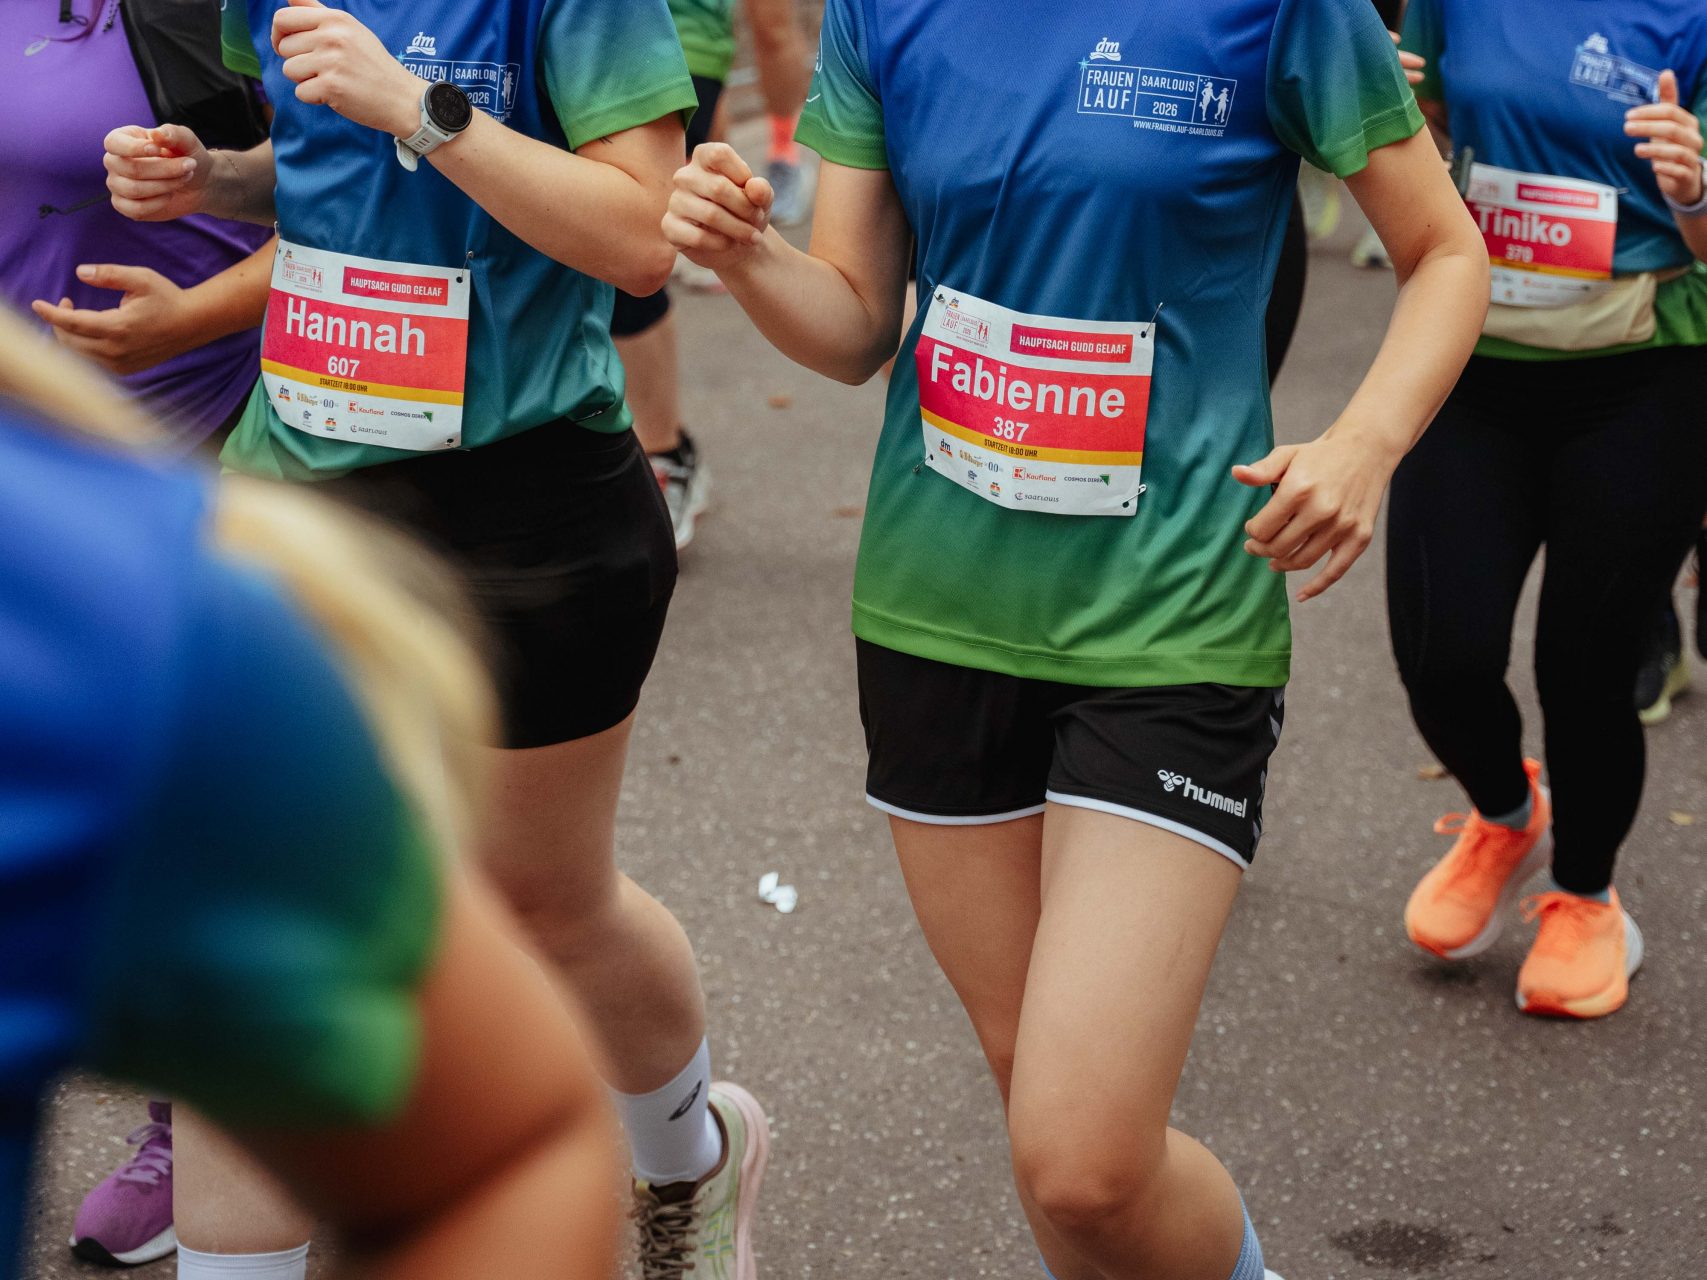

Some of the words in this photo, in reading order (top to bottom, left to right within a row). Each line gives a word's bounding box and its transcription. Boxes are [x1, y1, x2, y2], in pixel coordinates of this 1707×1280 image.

[411, 31, 436, 48] dm
[1095, 37, 1120, 54] dm
[1087, 69, 1134, 88] FRAUEN
[1141, 75, 1196, 93] SAARLOUIS
[467, 91, 490, 105] 2026
[1083, 87, 1132, 111] LAUF
[1152, 101, 1179, 118] 2026
[1133, 120, 1225, 138] WWW.FRAUENLAUF-SAARLOUIS.DE
[1474, 204, 1572, 247] Tiniko
[350, 276, 390, 291] HAUPTSACH
[391, 282, 412, 295] GUDD
[413, 285, 443, 297] GELAAF
[285, 296, 426, 357] Hannah
[1019, 335, 1069, 352] HAUPTSACH
[1070, 341, 1095, 354] GUDD
[1095, 342, 1127, 356] GELAAF
[327, 355, 360, 378] 607
[319, 377, 343, 389] STARTZEIT
[356, 384, 368, 393] UHR
[930, 342, 1126, 419] Fabienne
[358, 407, 385, 417] Kaufland
[992, 415, 1030, 443] 387
[940, 438, 951, 452] dm
[984, 438, 1008, 453] STARTZEIT
[1008, 446, 1024, 457] 18:00
[1024, 448, 1038, 458] UHR
[1026, 472, 1057, 483] Kaufland
[1063, 475, 1087, 483] COSMOS
[1183, 777, 1248, 819] hummel
